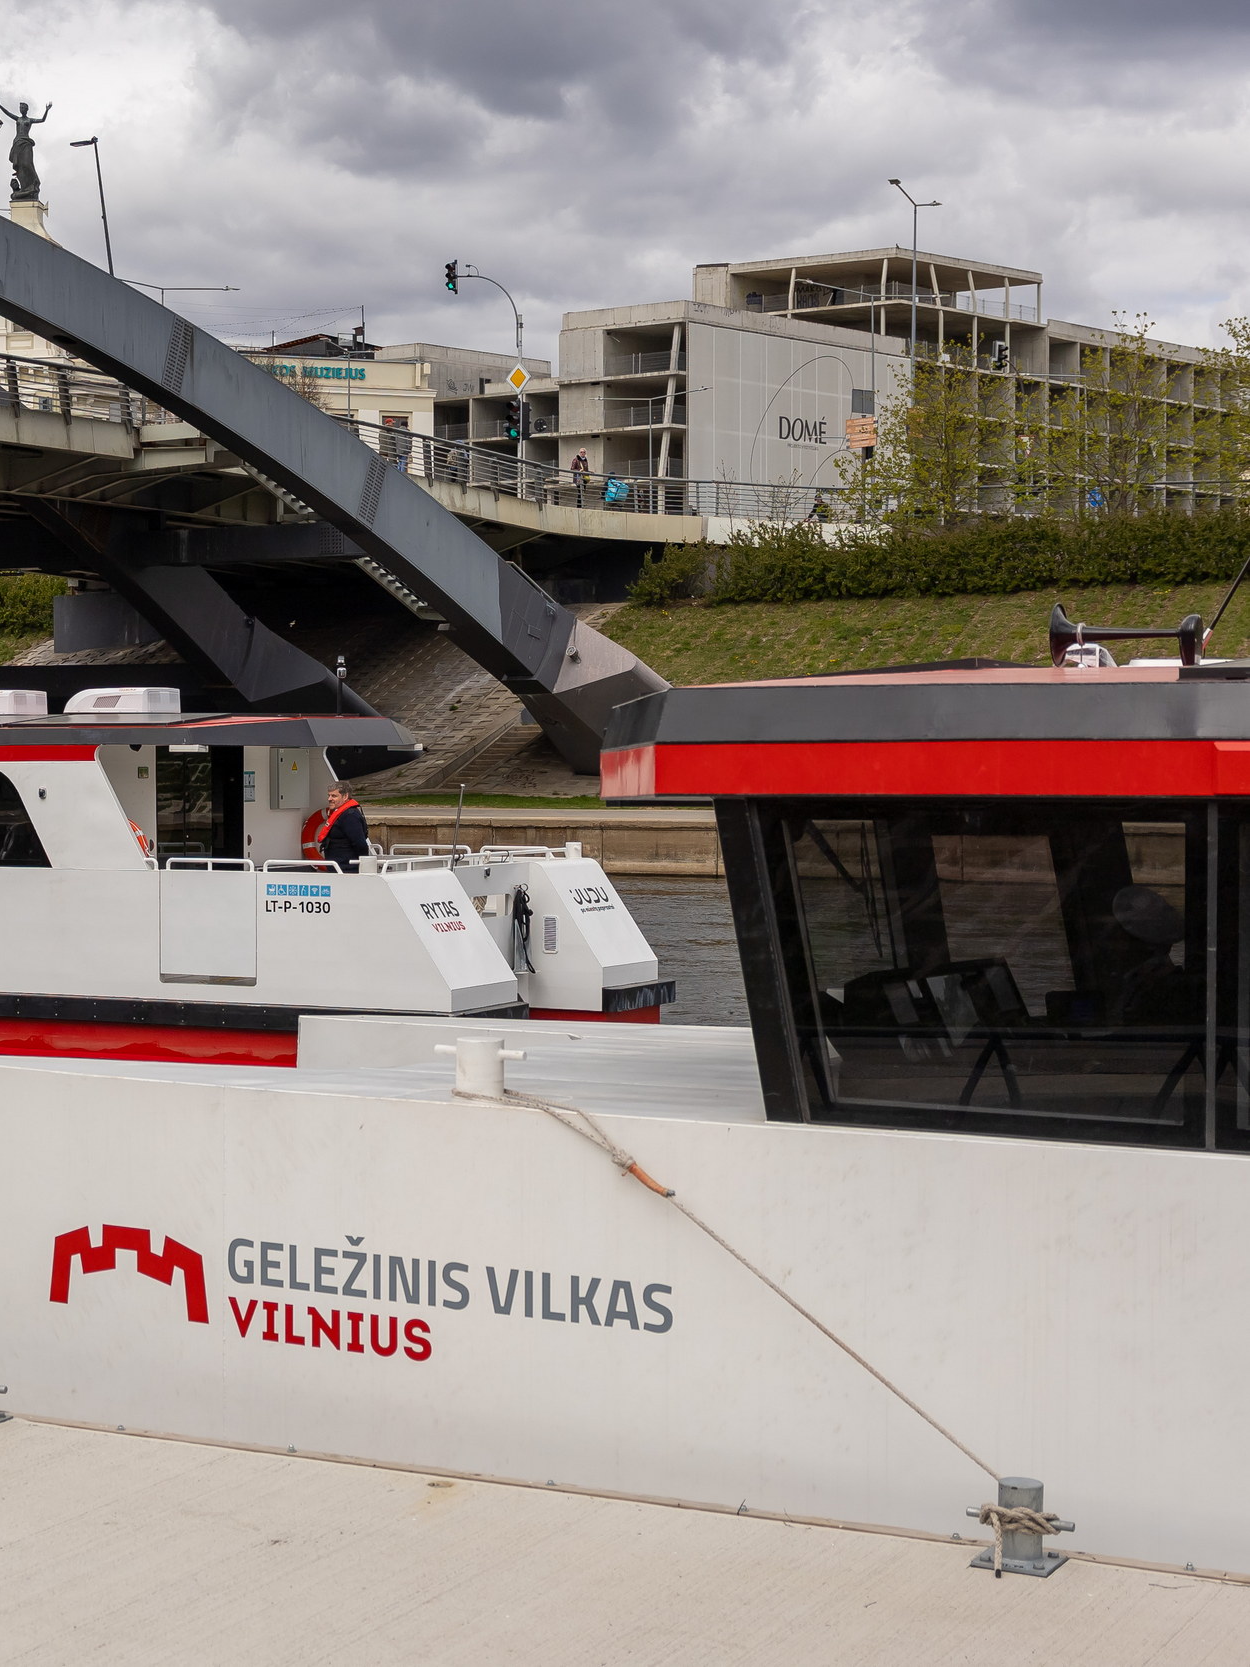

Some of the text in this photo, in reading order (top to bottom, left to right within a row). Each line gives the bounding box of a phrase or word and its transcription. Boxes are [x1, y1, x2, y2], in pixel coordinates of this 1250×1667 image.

[302, 366, 366, 380] MUZIEJUS
[779, 416, 827, 445] DOMÉ
[569, 886, 609, 905] JUDU
[265, 900, 331, 914] LT-P-1030
[419, 900, 460, 920] RYTAS
[431, 920, 466, 932] VILNIUS
[227, 1235, 674, 1334] GELEŽINIS VILKAS
[228, 1296, 432, 1362] VILNIUS
